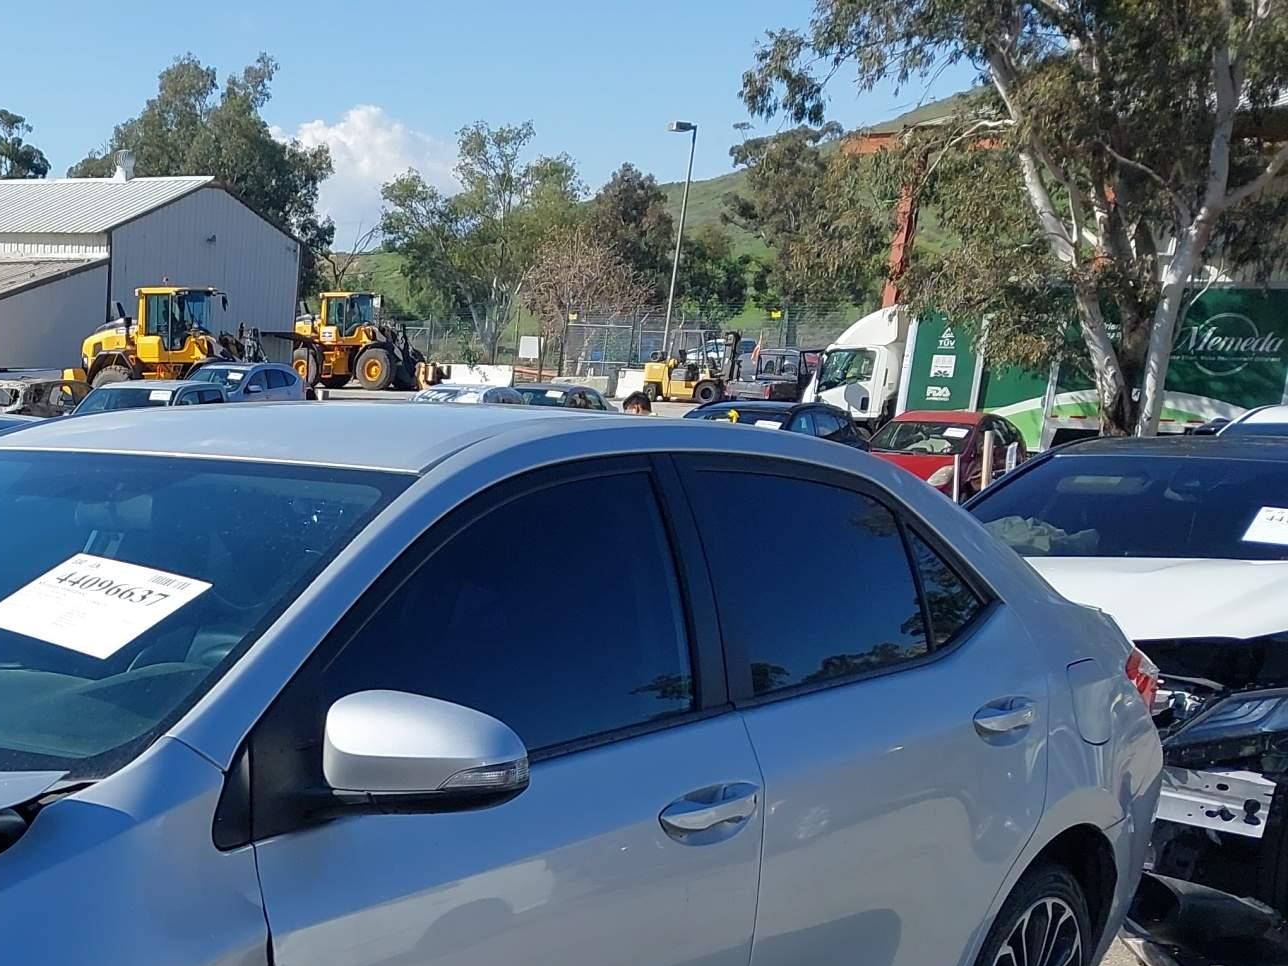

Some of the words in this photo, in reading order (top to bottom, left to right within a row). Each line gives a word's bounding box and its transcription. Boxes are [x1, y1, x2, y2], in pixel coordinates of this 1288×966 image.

[938, 338, 955, 347] TÜV
[1175, 325, 1285, 354] Memeda
[926, 386, 951, 397] FDA
[55, 571, 171, 607] 44096637
